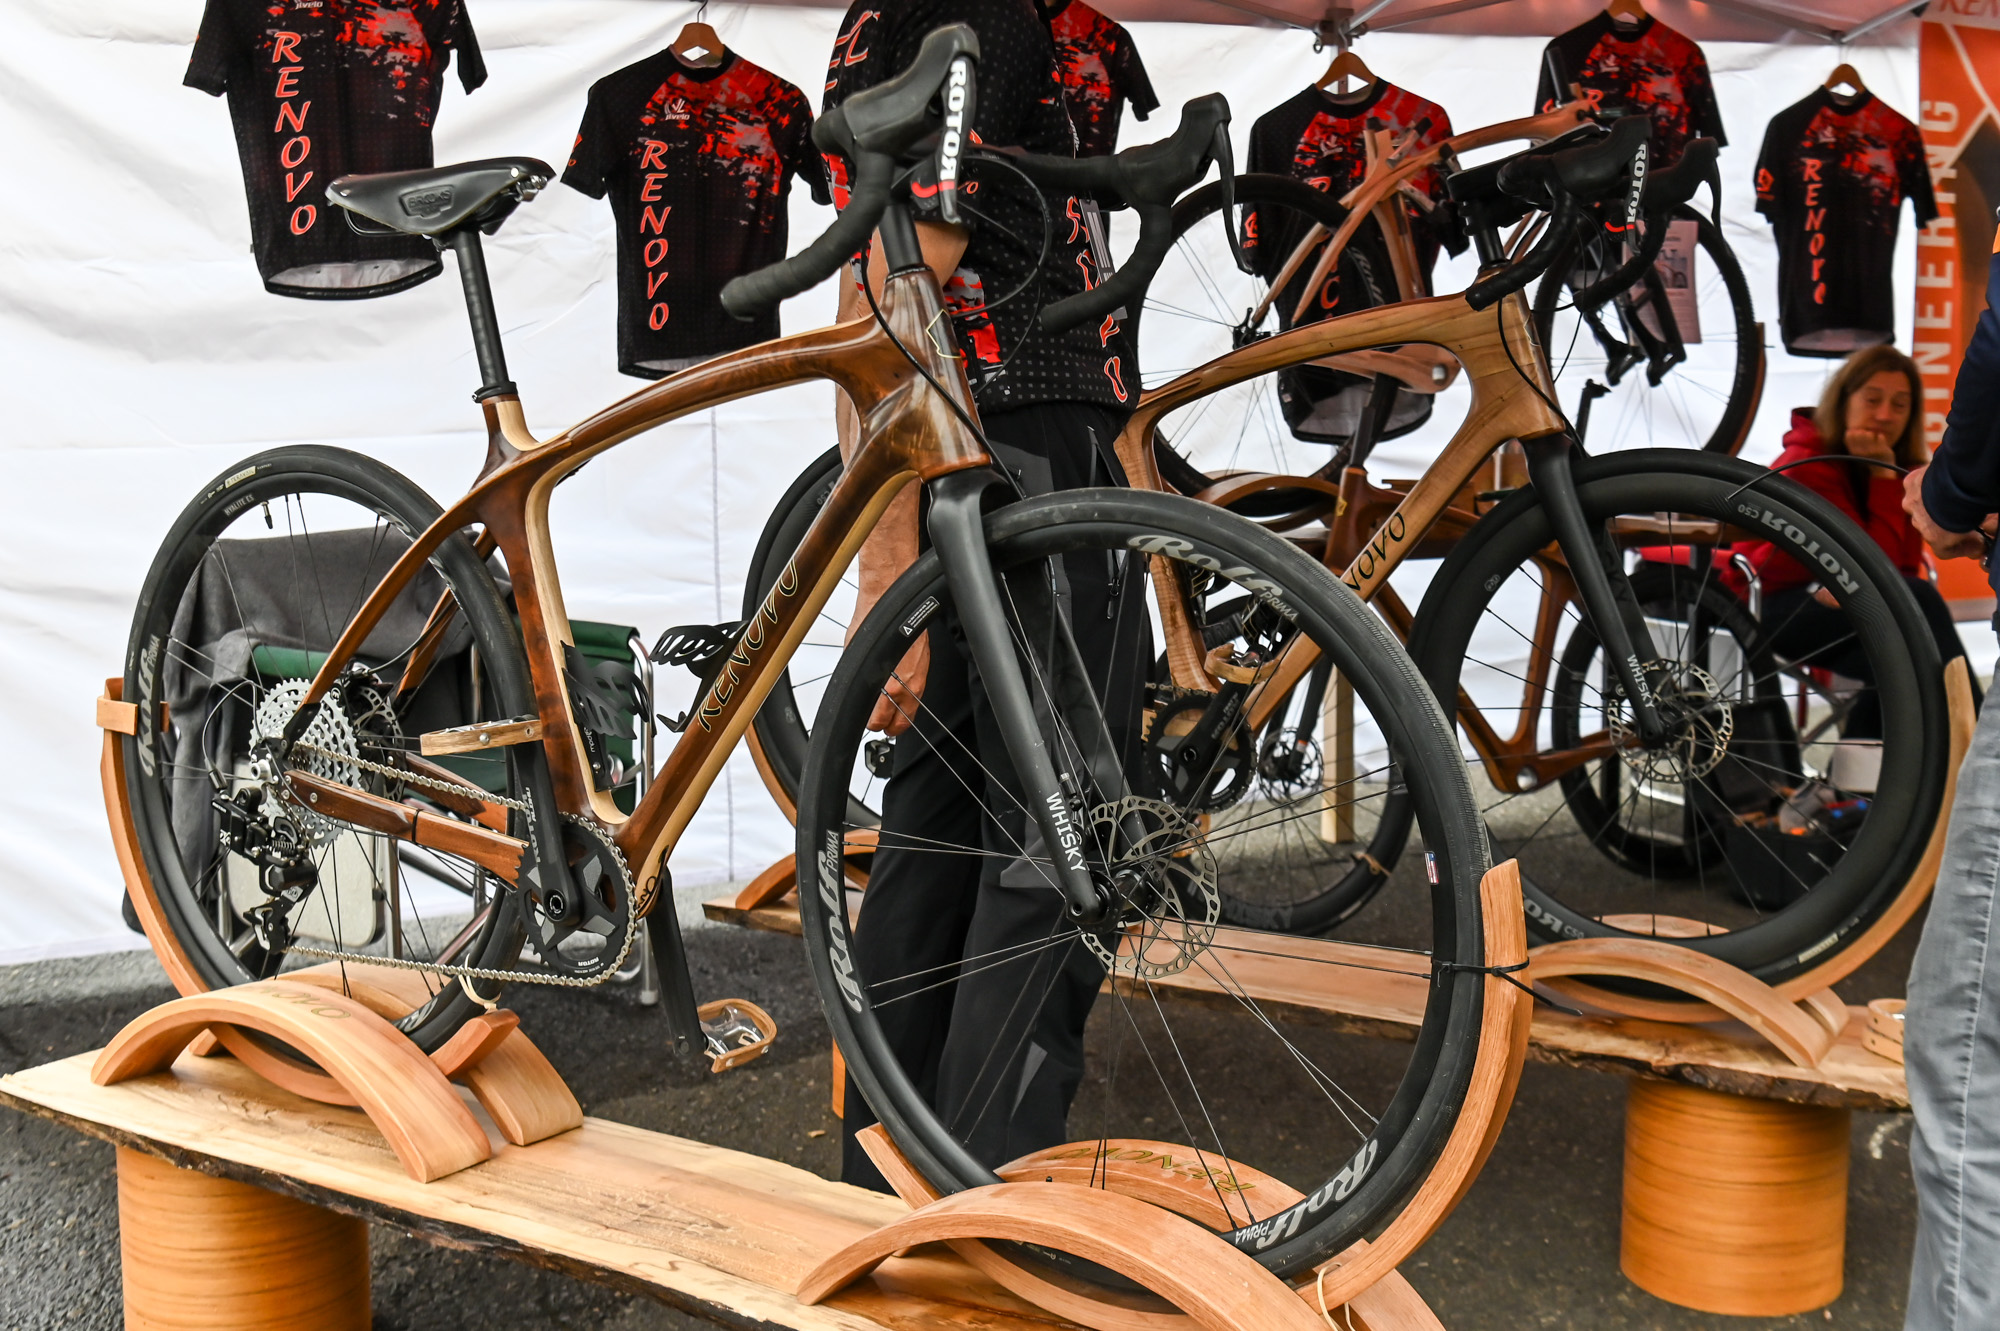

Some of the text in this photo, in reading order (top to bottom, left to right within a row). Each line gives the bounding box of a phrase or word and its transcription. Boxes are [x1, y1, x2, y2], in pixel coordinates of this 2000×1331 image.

[272, 31, 317, 236] RENOVO
[940, 60, 967, 181] ROTOR
[1627, 143, 1647, 223] ROTOR
[640, 140, 671, 330] RENOVO
[1738, 504, 1860, 595] ROTOR C50
[698, 558, 798, 733] RENOVO
[1259, 591, 1299, 622] PRIMA
[146, 633, 161, 667] PRIMA
[1627, 654, 1655, 708] WHISKY
[826, 829, 840, 873] PRIMA
[1046, 791, 1087, 871] WHISKY
[1046, 1147, 1257, 1195] RENOVO
[1235, 1138, 1378, 1250] Rolf PRIMA
